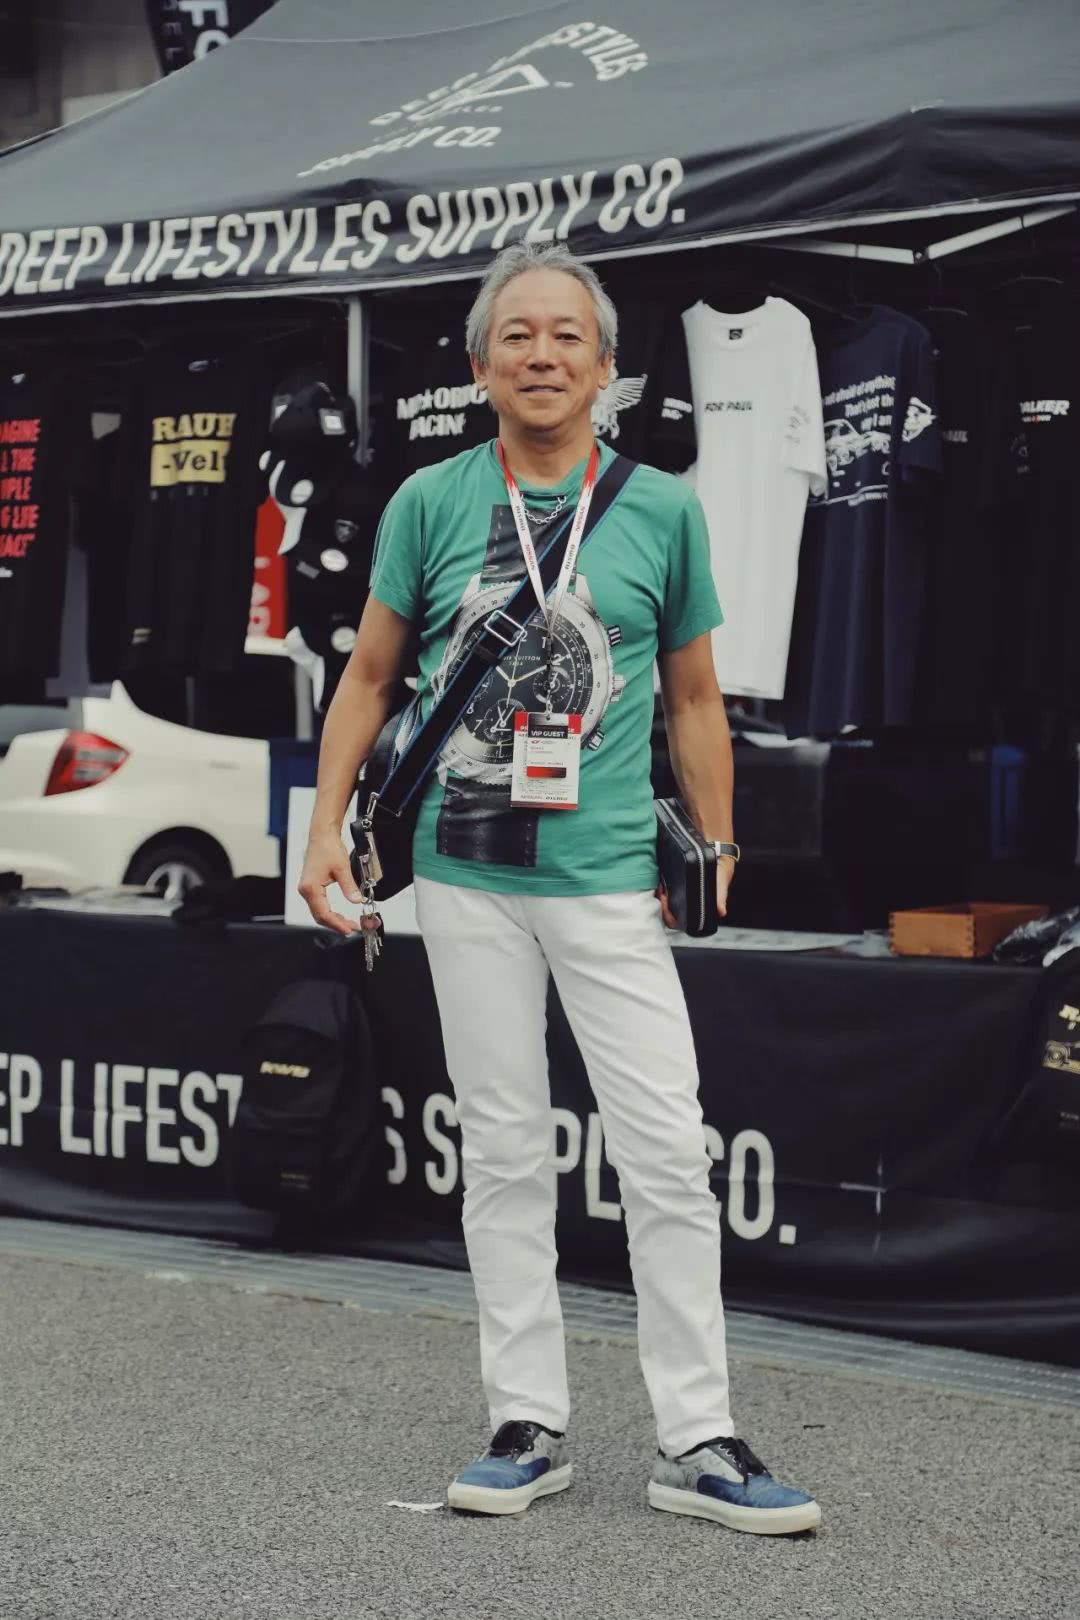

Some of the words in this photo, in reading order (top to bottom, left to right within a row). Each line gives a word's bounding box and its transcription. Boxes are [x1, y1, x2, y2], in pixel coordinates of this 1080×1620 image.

[0, 226, 107, 296] DEEP
[104, 200, 391, 287] LIFESTYLES
[395, 170, 598, 264] SUPPLY
[598, 157, 686, 234] CO.
